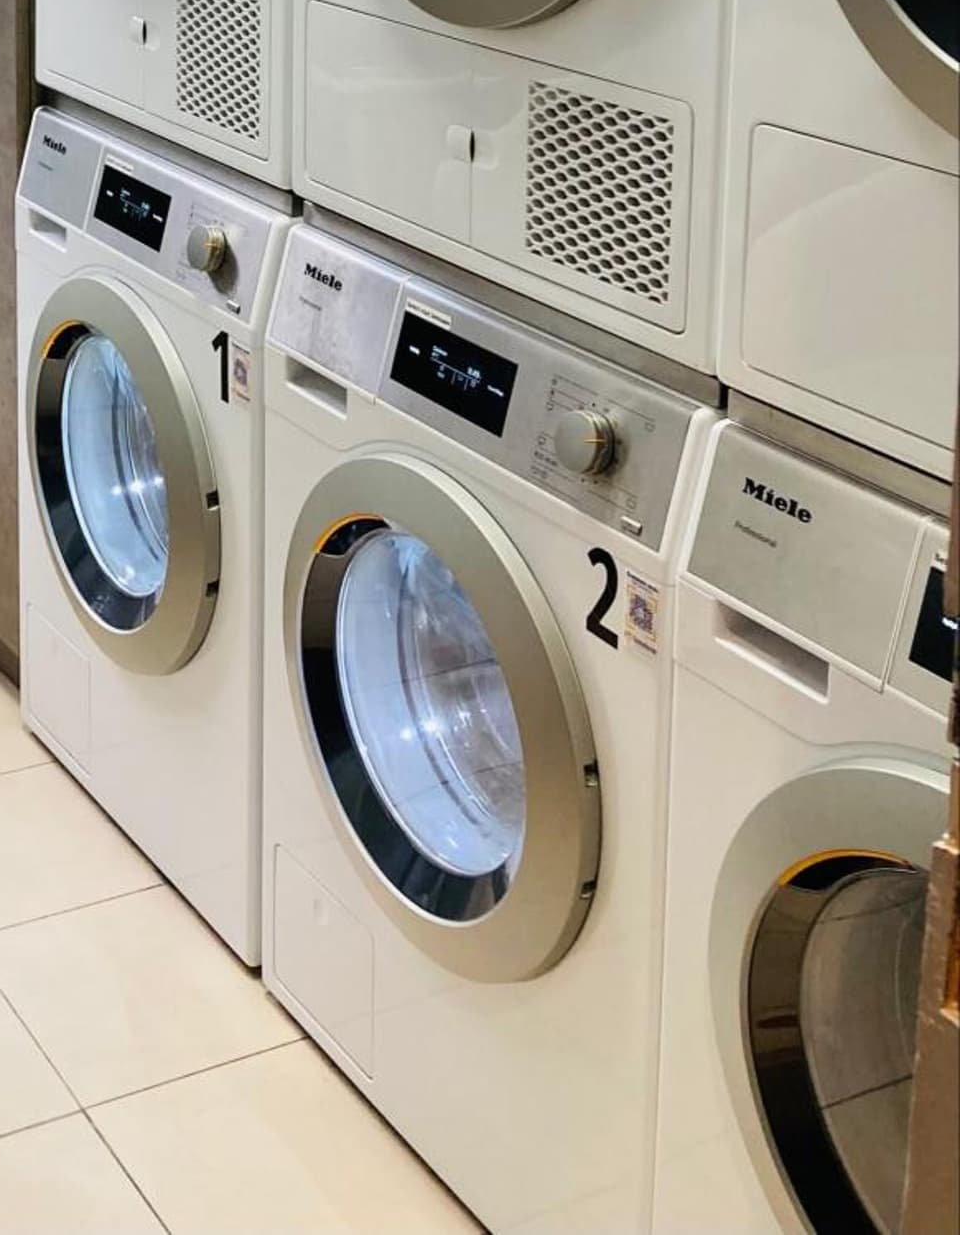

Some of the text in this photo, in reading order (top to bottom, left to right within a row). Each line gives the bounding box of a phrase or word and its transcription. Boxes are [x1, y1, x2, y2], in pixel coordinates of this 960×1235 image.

[43, 135, 66, 155] Miele
[304, 263, 343, 291] Miele
[211, 330, 230, 404] 1
[742, 477, 813, 523] Miele
[586, 547, 619, 650] 2
